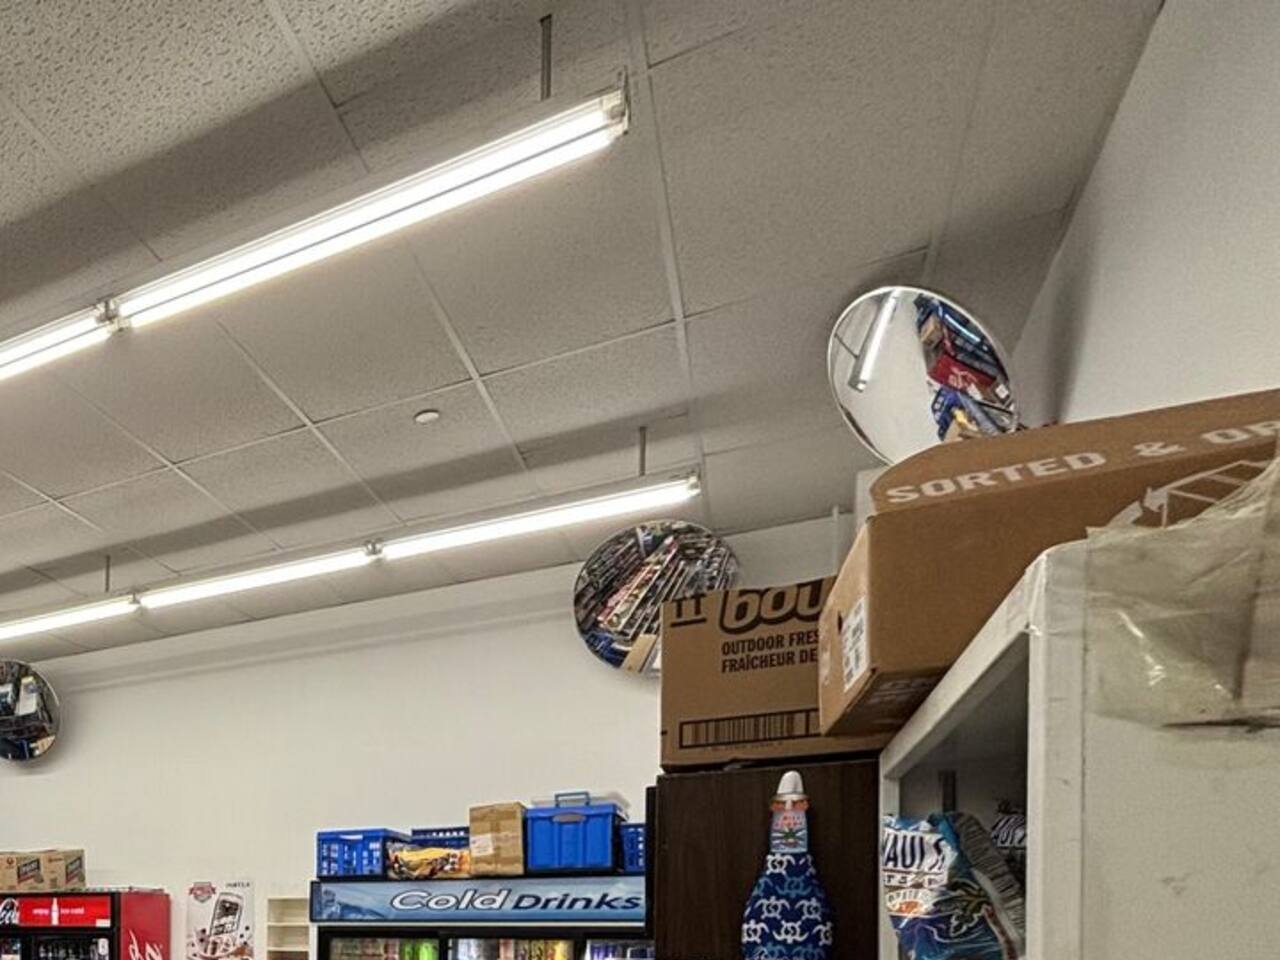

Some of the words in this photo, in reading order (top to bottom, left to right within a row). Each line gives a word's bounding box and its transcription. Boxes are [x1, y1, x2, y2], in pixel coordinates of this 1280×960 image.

[886, 452, 1107, 503] SORTED
[1133, 441, 1187, 458] &
[721, 633, 785, 656] OUTDOOR
[391, 888, 510, 912] Cold
[511, 893, 641, 912] Drinks
